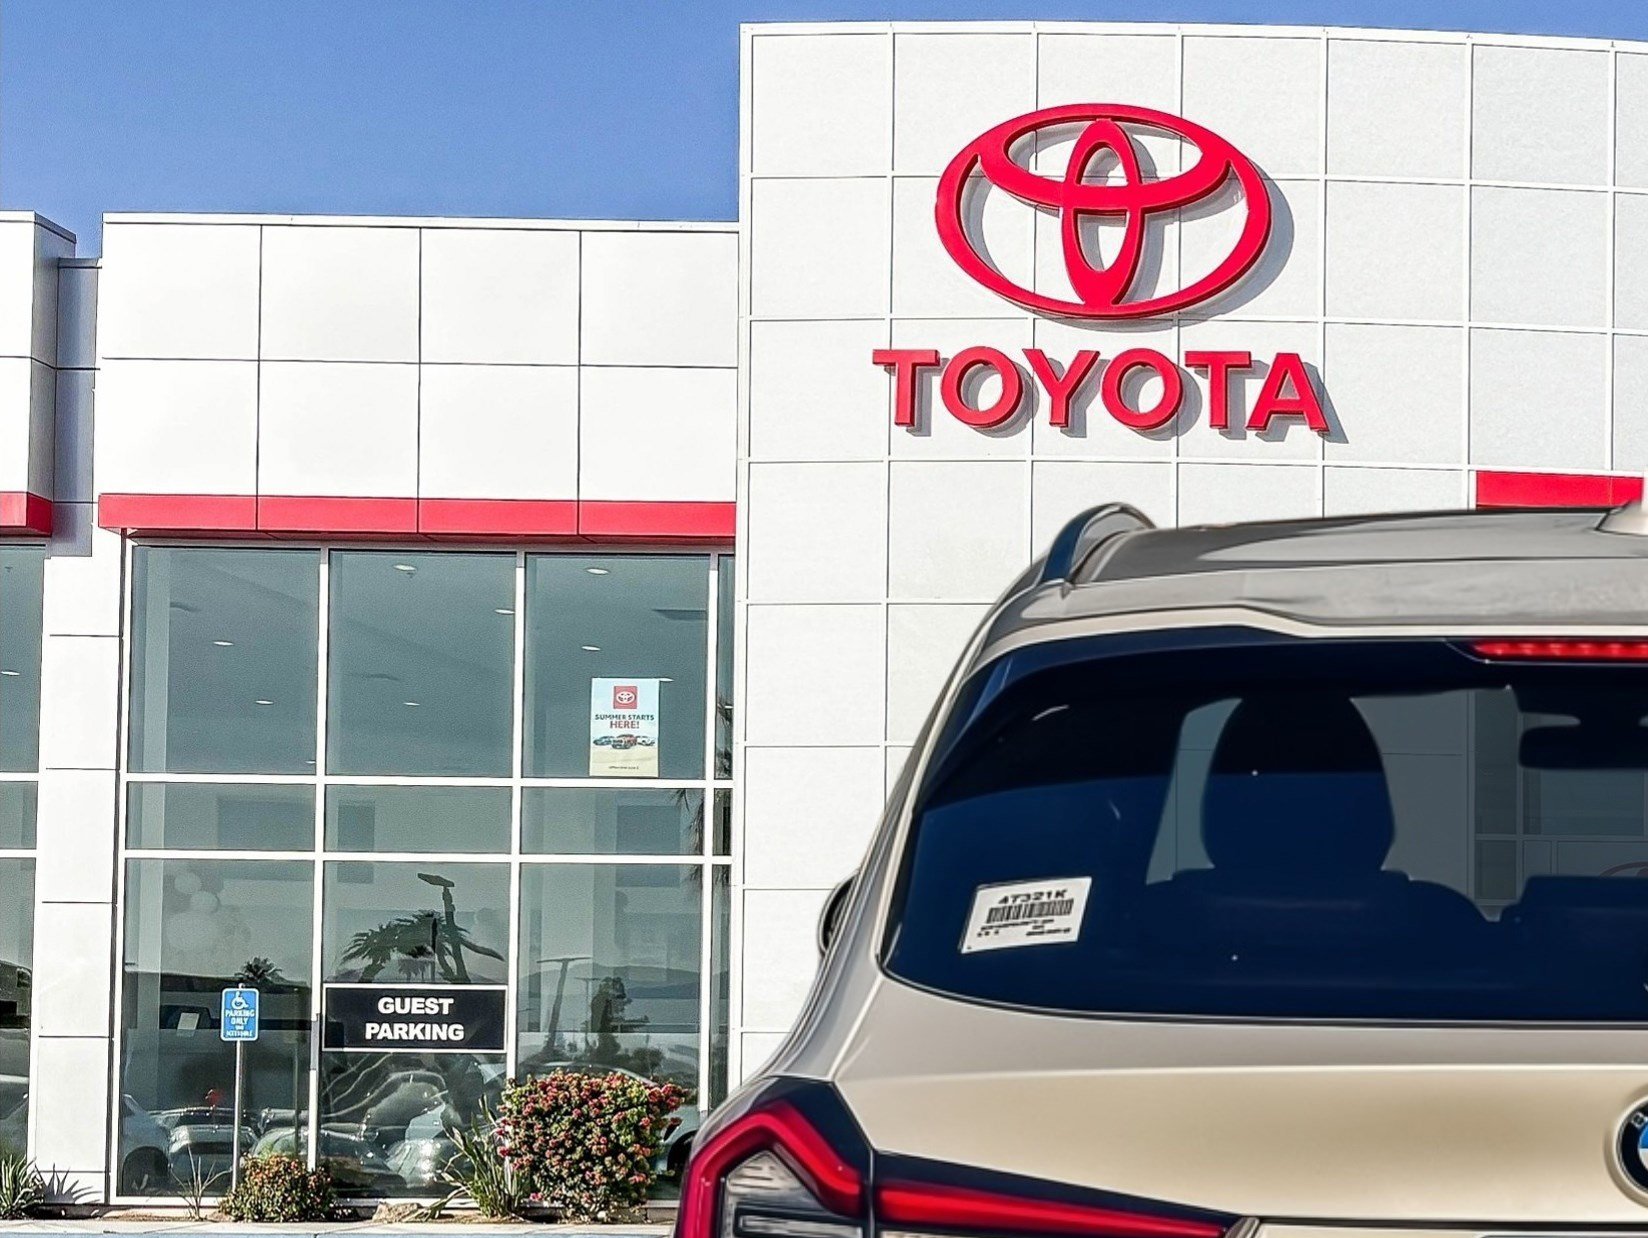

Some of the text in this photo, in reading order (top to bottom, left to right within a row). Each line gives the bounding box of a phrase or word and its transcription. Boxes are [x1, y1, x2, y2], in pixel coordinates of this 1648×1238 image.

[872, 346, 1330, 433] TOYOTA
[609, 720, 640, 729] HERE!
[225, 1009, 255, 1018] PARKING
[377, 997, 454, 1015] GUEST
[365, 1022, 465, 1041] PARKING
